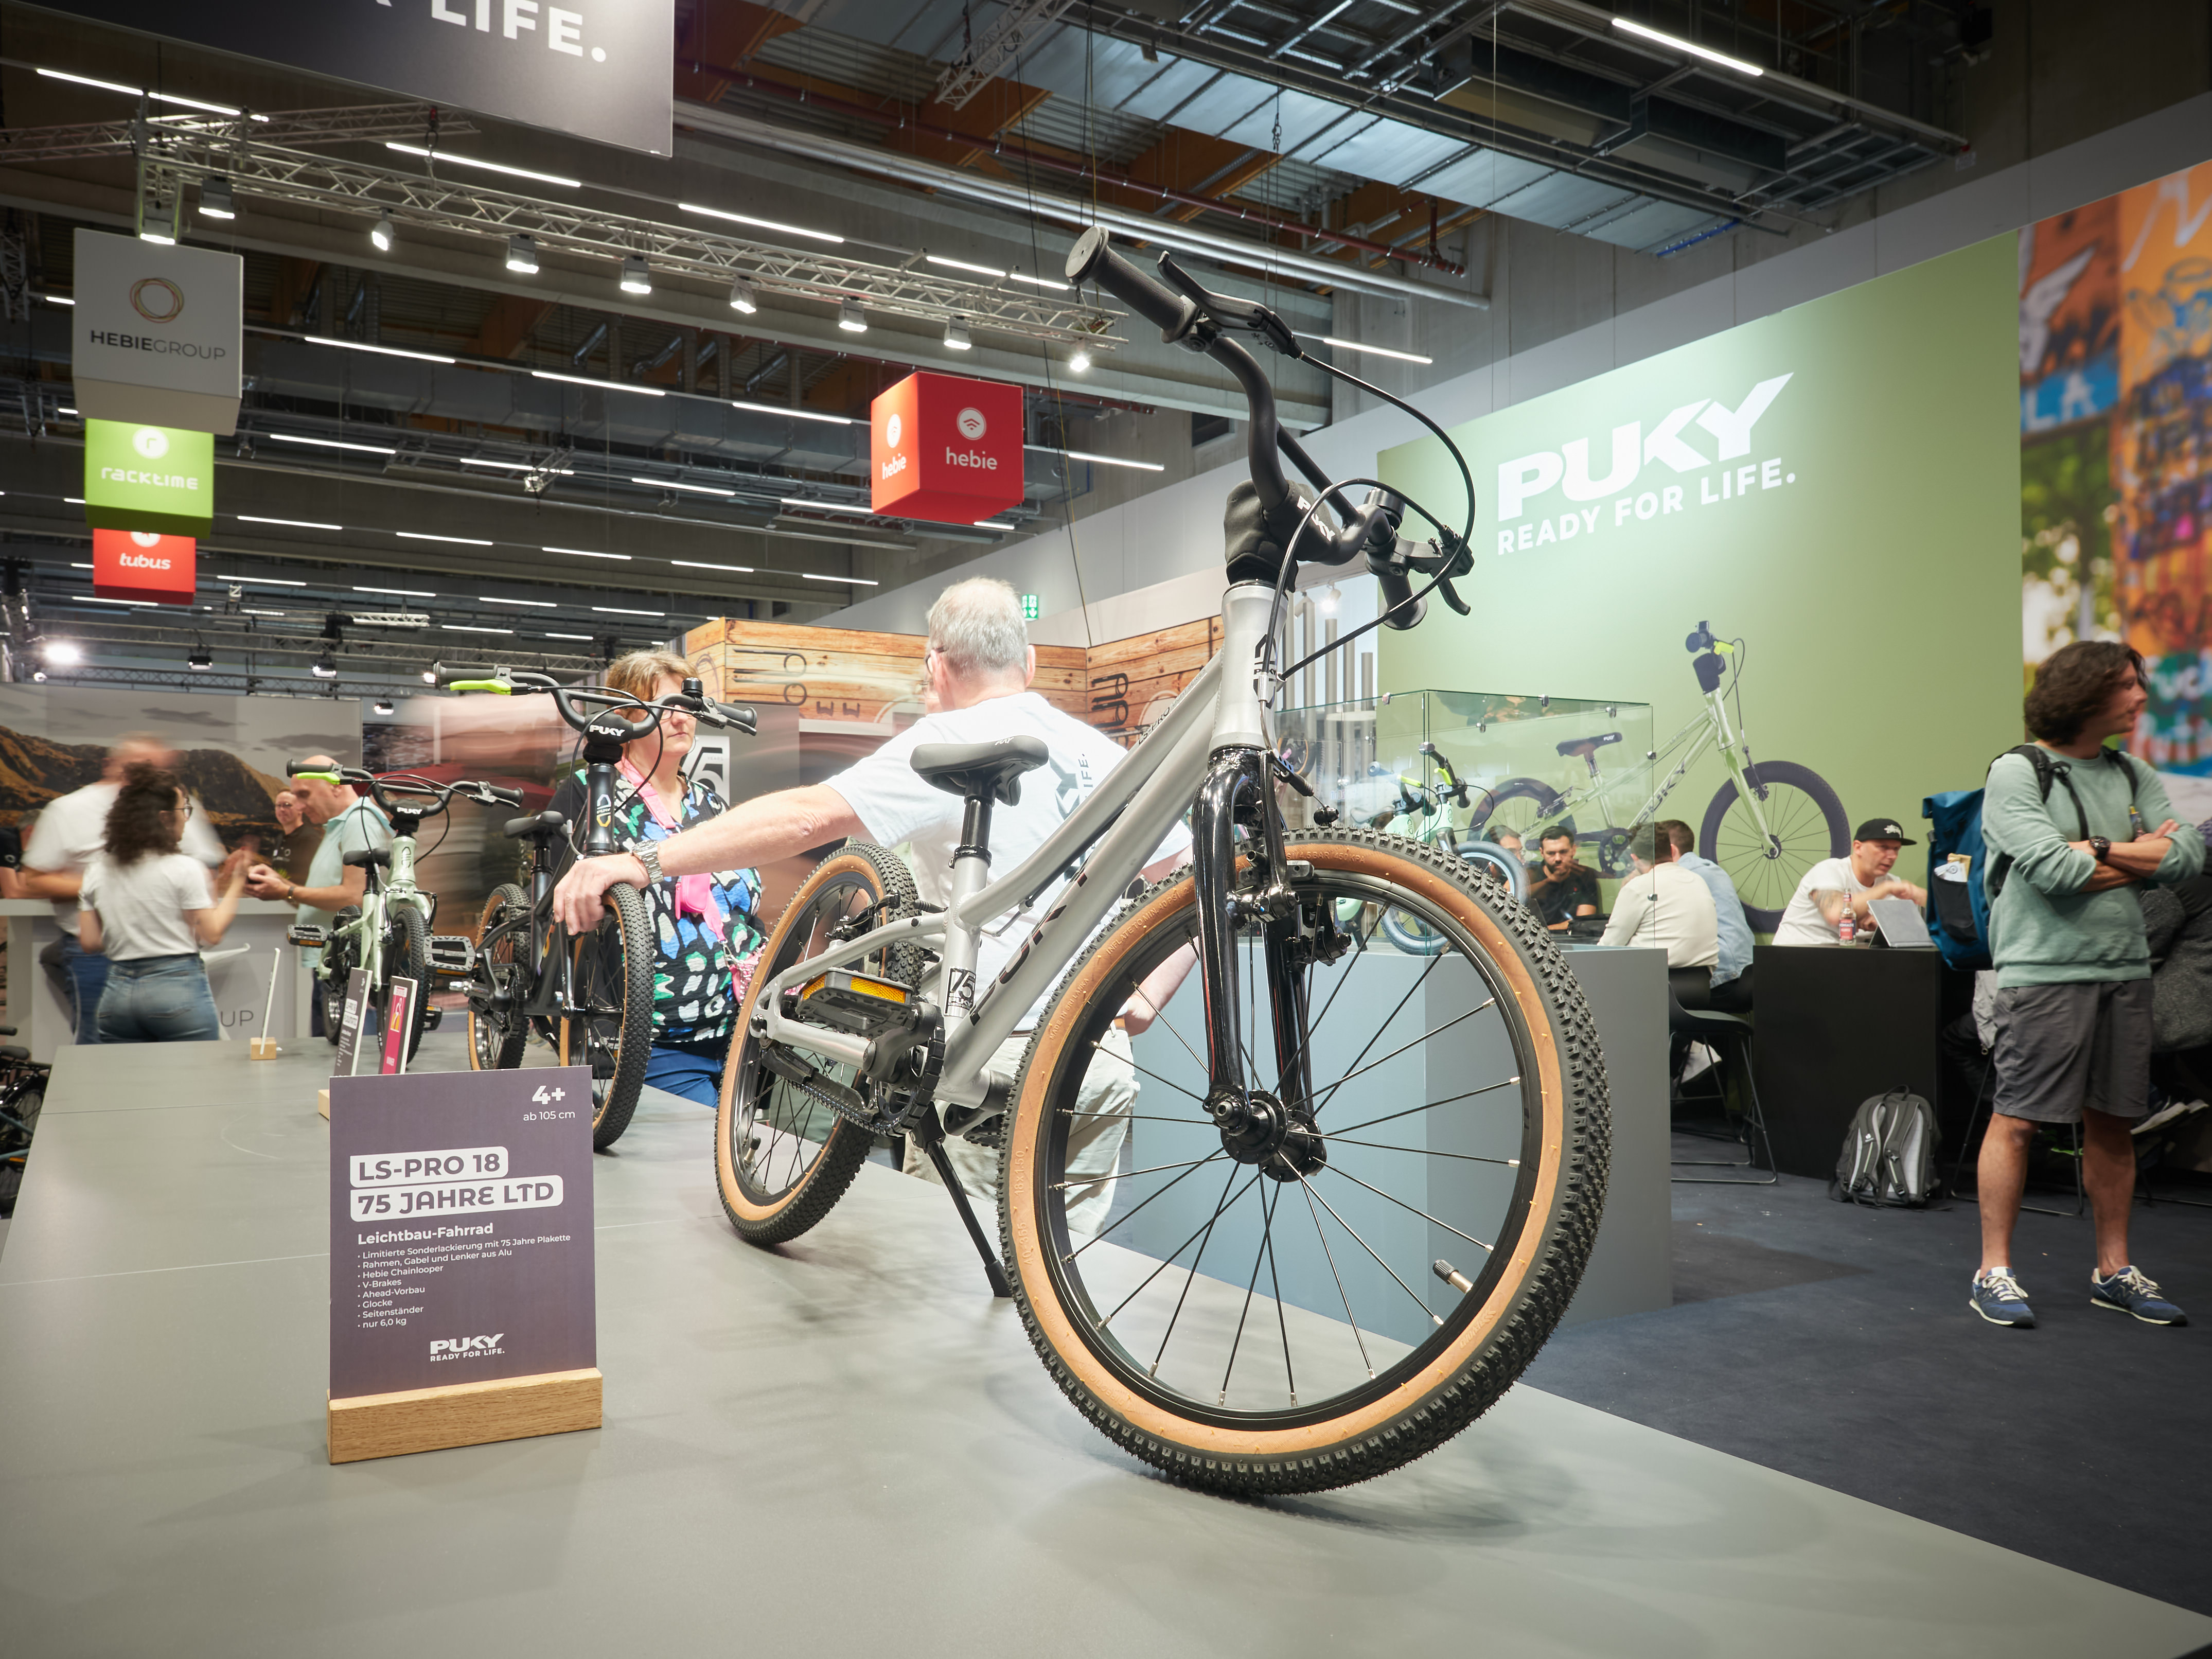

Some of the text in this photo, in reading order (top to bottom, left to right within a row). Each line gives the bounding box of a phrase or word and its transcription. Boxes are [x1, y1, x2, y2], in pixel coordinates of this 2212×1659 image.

[431, 0, 606, 62] LIFE.
[90, 330, 226, 360] HEBIEGROUP
[946, 447, 997, 470] hebie
[1498, 372, 1794, 522] PUKY
[882, 453, 906, 480] hebie
[101, 467, 198, 490] racktime
[1498, 457, 1795, 555] READY FOR LIFE.
[119, 553, 171, 570] tubus
[589, 725, 625, 736] PUKY
[1139, 707, 1170, 745] LS-PRO
[1077, 753, 1094, 798] IFE.
[1106, 927, 1134, 955] INFLATE
[1132, 919, 1143, 929] TO
[1049, 977, 1089, 1040] MADE IN SRI LANKA
[532, 1085, 565, 1105] 4+
[523, 1110, 575, 1121] ab 105 cm
[360, 1153, 500, 1181] LS-PRO 18
[1014, 1150, 1025, 1197] 18x1.50
[358, 1183, 554, 1215] 75 JAHRE LTD
[358, 1223, 493, 1245] Leichtbau-Fahrrad
[1018, 1222, 1033, 1266] 40-355
[363, 1248, 405, 1259] Limitierte
[407, 1242, 483, 1256] Sonderlackierung
[485, 1240, 499, 1248] mit
[512, 1237, 535, 1246] Jahre
[537, 1234, 571, 1243] Plakette
[363, 1259, 402, 1269] Rahmen,
[404, 1256, 429, 1265] Gabel
[431, 1255, 448, 1263] und
[451, 1251, 480, 1261] Lenker
[498, 1248, 512, 1257] Alu
[363, 1265, 444, 1279] Hebie Chainlooper
[363, 1279, 402, 1289] V-Brakes
[363, 1286, 425, 1299] Ahead-Vorbau
[363, 1299, 393, 1309] Glocke
[363, 1305, 424, 1319] Seitenständer
[363, 1317, 406, 1329] nur 6,0 kg
[430, 1333, 504, 1354] PUKY
[430, 1348, 505, 1362] READY FOR LIFE.
